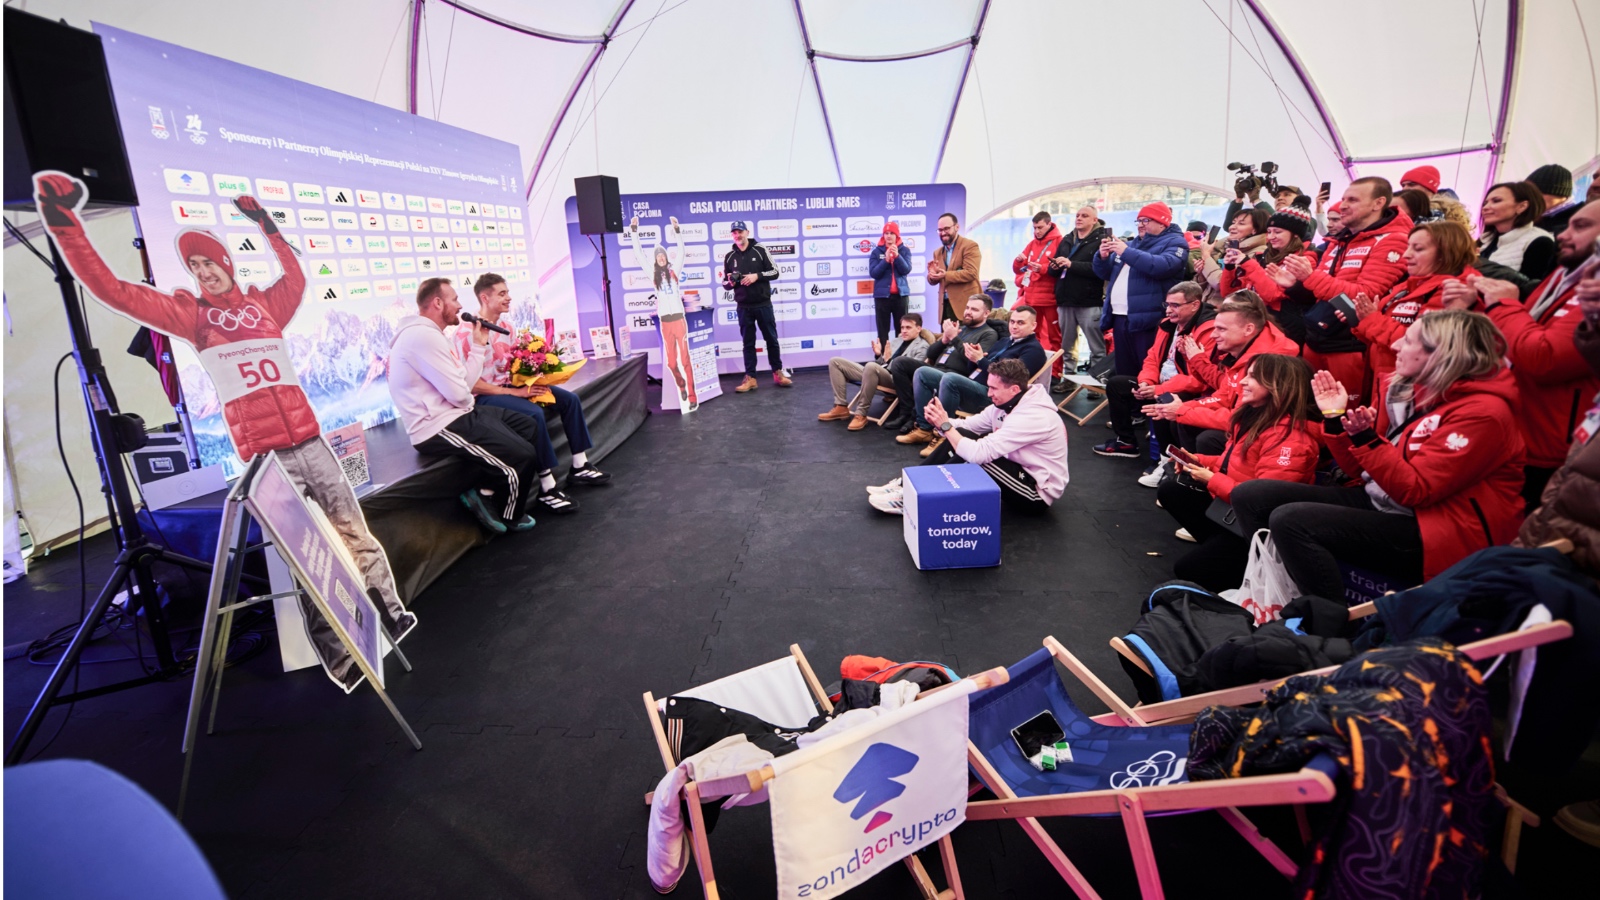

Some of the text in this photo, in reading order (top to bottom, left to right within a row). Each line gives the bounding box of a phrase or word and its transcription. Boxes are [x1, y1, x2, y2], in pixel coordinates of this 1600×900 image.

[219, 127, 272, 149] Sponsorzy
[273, 136, 277, 147] i
[279, 139, 319, 157] Partnerzy
[320, 145, 363, 164] Olimpijskiej
[365, 154, 404, 170] Reprezentacji
[405, 161, 422, 171] Polski
[430, 165, 441, 175] XXV
[219, 181, 237, 191] plus
[902, 193, 916, 201] CASA
[632, 201, 649, 210] CASA
[690, 201, 714, 214] CASA
[715, 199, 752, 213] POLONIA
[755, 198, 797, 211] PARTNERS
[806, 196, 834, 209] LUBLIN
[836, 196, 861, 208] SMES
[767, 245, 792, 253] DAREX
[218, 344, 279, 360] PyeongChang 2018
[237, 358, 281, 388] 50
[942, 511, 976, 523] trade
[927, 526, 992, 538] tomorrow,
[941, 538, 978, 551] today
[1349, 570, 1388, 594] trad
[797, 807, 957, 897] zondacrypto
